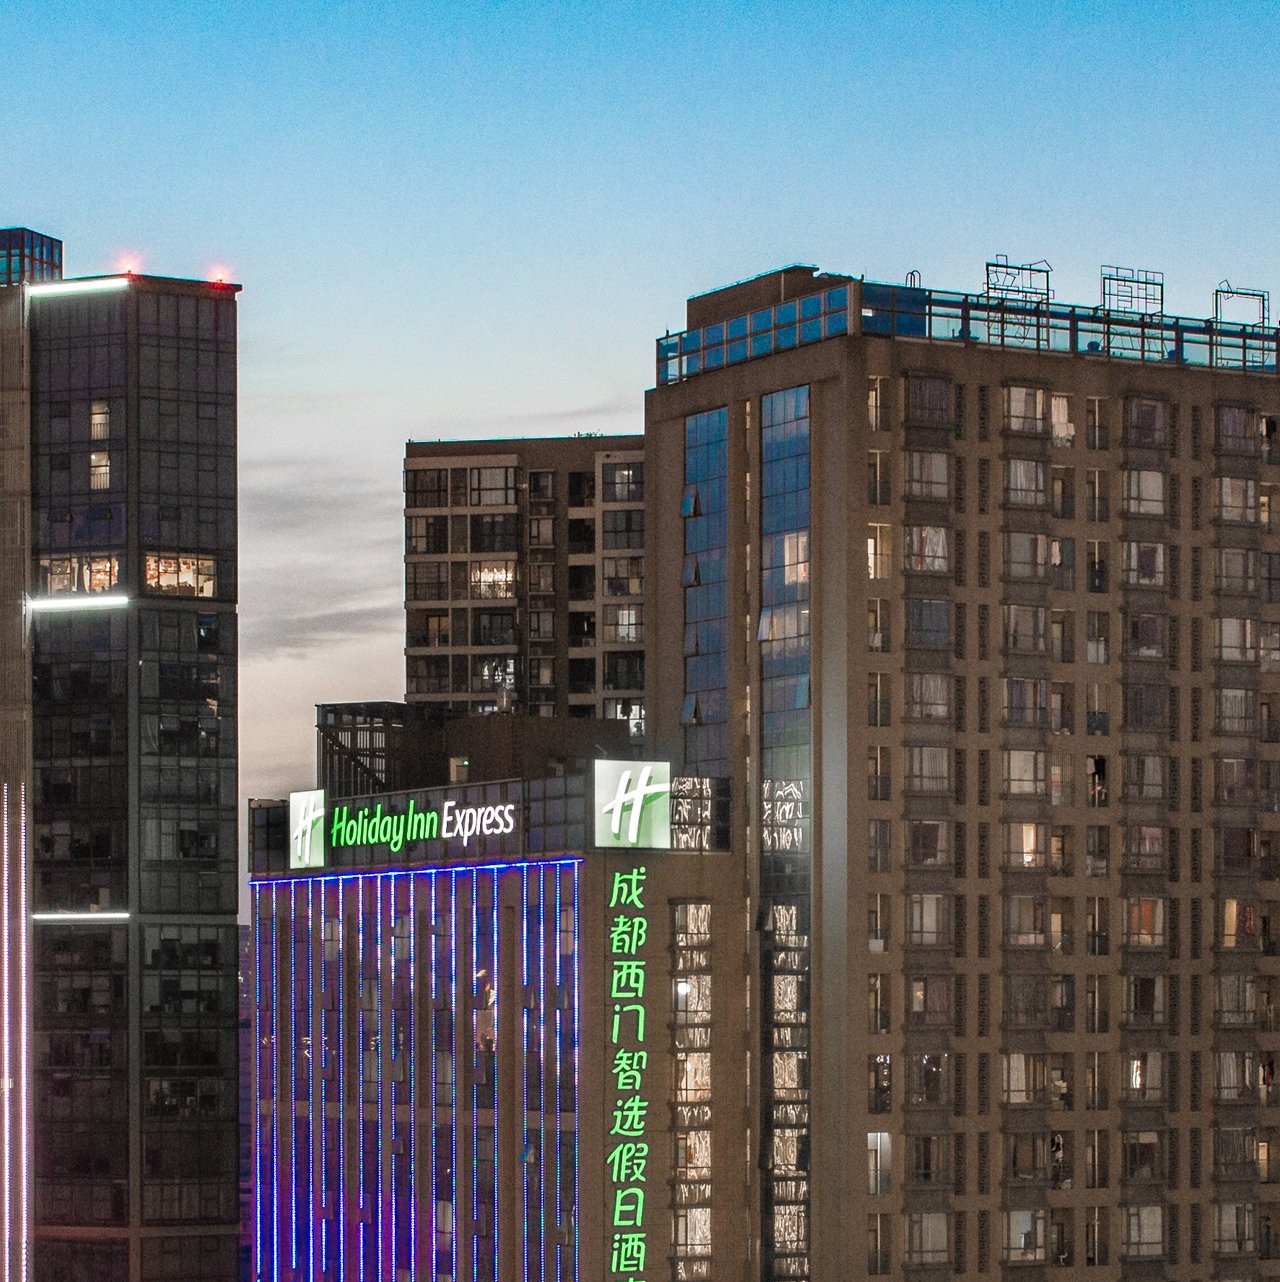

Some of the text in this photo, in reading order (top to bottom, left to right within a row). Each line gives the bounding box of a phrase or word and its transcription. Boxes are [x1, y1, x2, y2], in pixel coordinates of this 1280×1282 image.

[331, 799, 516, 853] Holiday Inn Express
